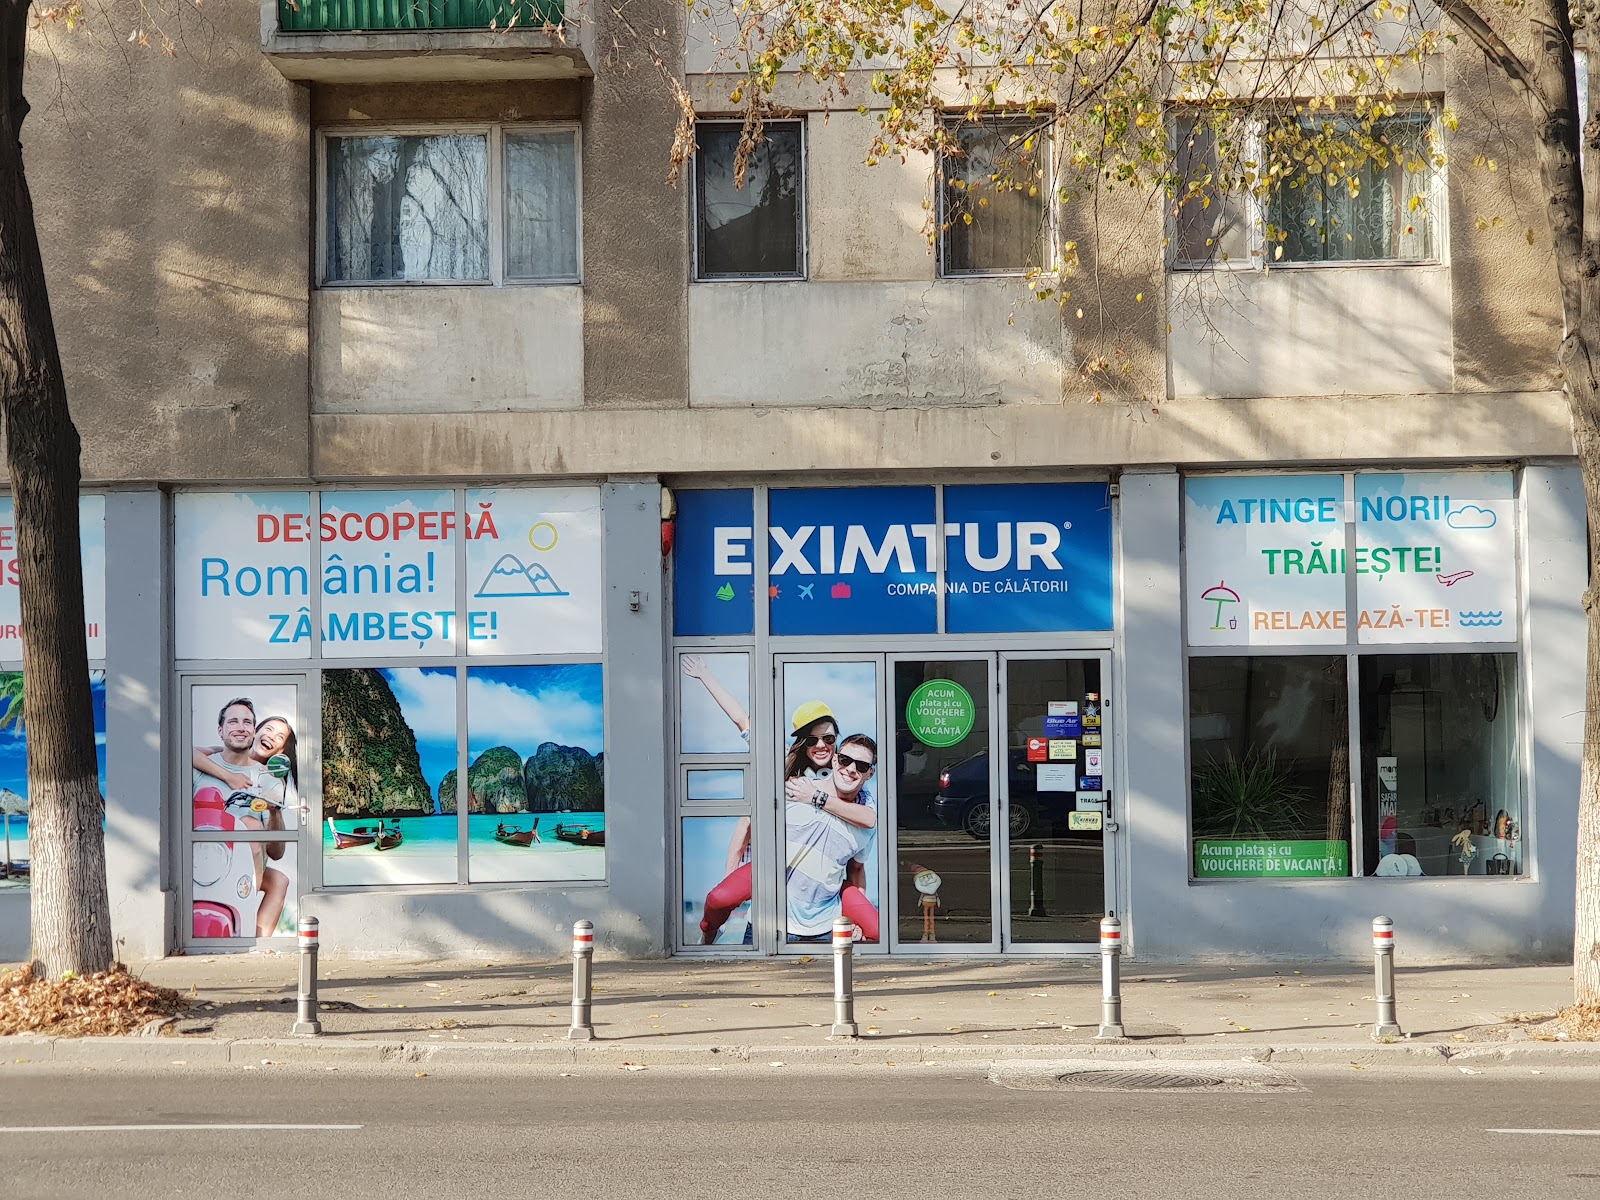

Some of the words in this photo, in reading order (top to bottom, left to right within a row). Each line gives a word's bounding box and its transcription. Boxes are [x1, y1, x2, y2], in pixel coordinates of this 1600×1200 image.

[1216, 497, 1336, 524] ATINGE
[257, 502, 499, 542] DESCOPERĂ
[713, 520, 1064, 576] EXIMTUR
[1261, 541, 1442, 581] TRĂIEȘTE!
[201, 551, 434, 597] România!
[887, 581, 968, 596] COMPANIA
[972, 581, 990, 594] DE
[994, 577, 1068, 594] CĂLĂTORII
[268, 606, 497, 649] ZÂMBEȘTE!
[927, 689, 955, 697] ACUM
[916, 708, 965, 716] VOUCHERE
[920, 699, 942, 708] plata
[934, 717, 947, 725] DE
[1201, 843, 1233, 856] Acum
[1235, 843, 1264, 858] plata
[1278, 846, 1292, 856] cu
[1201, 859, 1263, 872] VOUCHERE
[1266, 859, 1281, 871] DE
